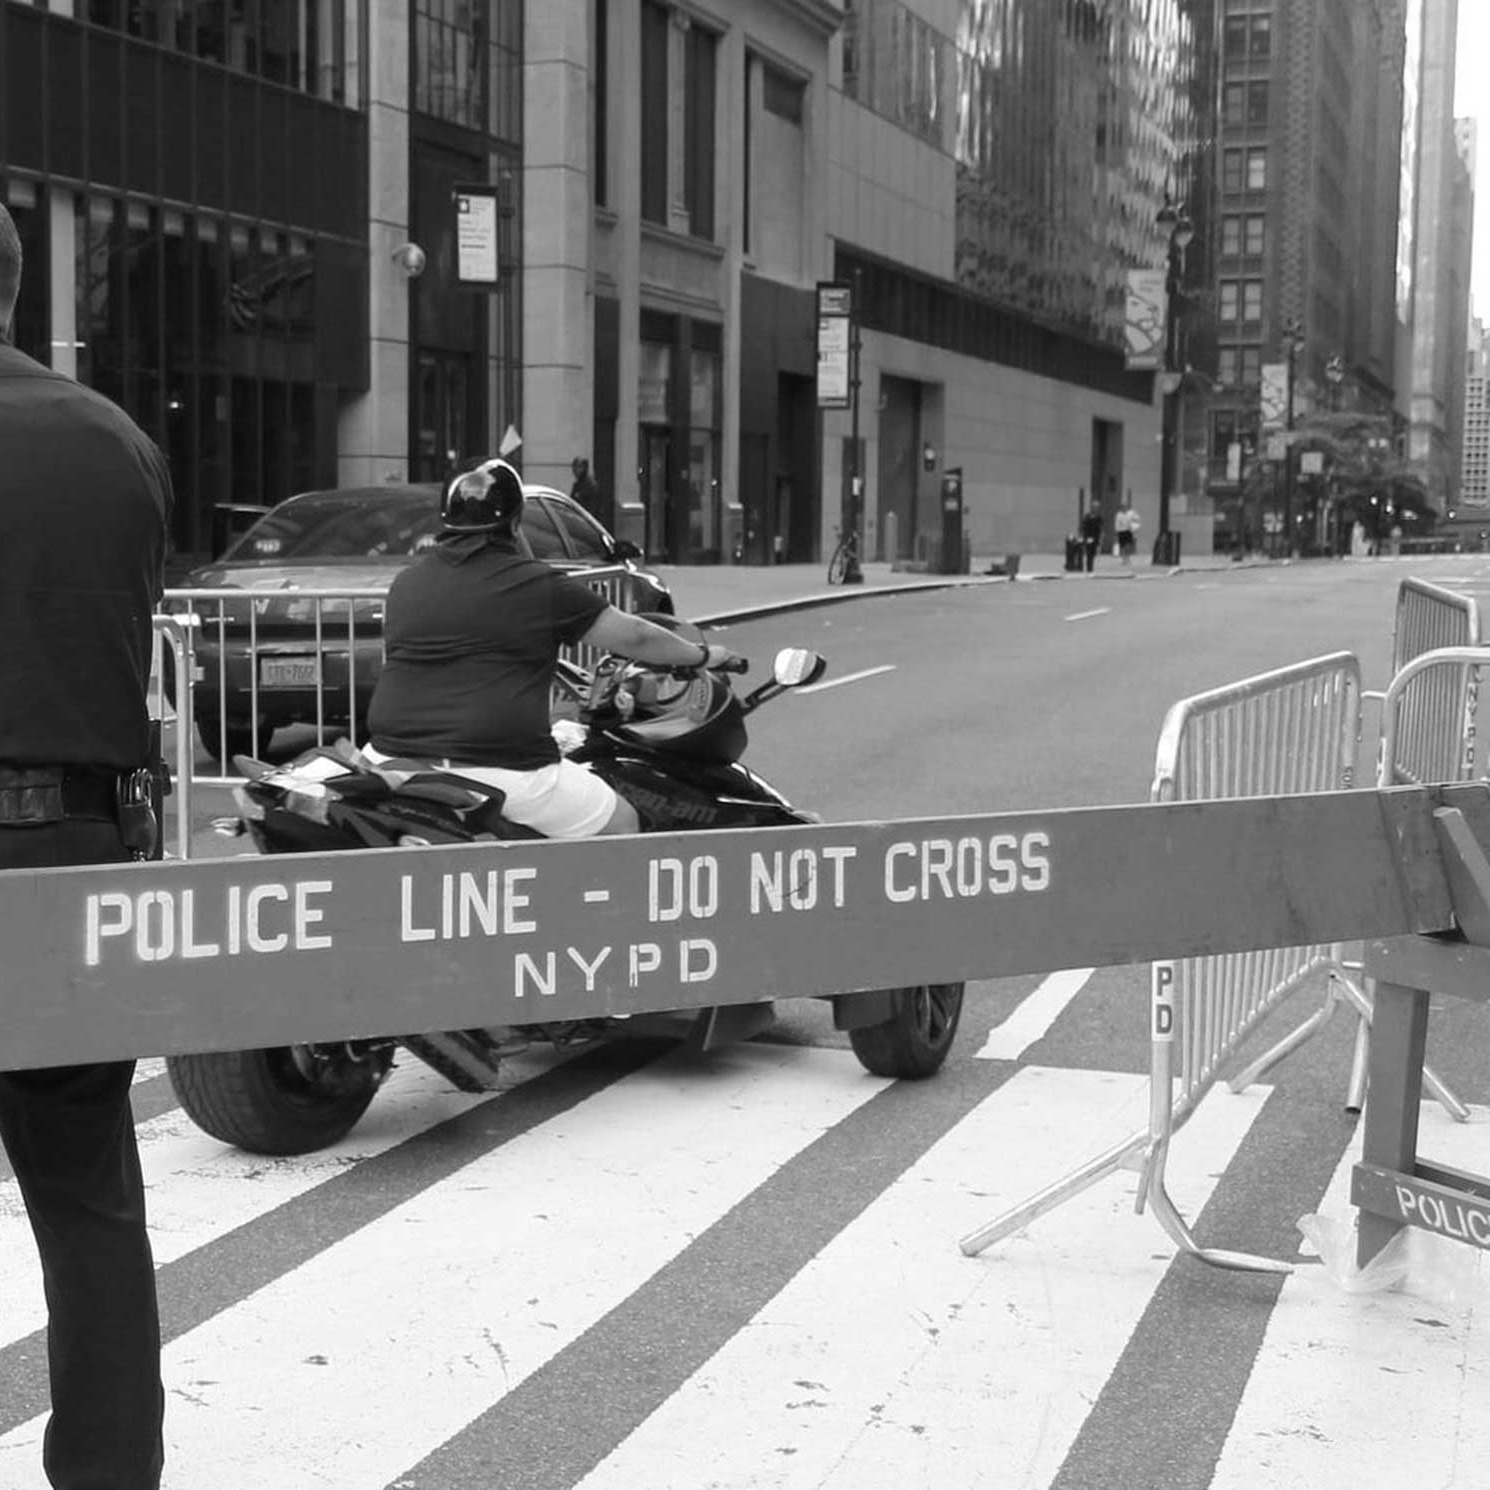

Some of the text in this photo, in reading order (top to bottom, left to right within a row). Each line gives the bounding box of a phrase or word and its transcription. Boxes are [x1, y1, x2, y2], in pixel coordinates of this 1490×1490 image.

[84, 880, 334, 966] POLICE
[401, 867, 538, 942] LINE
[648, 855, 719, 922] DO
[750, 848, 861, 914] NOT
[884, 832, 1051, 904] CROSS
[514, 938, 719, 998] NYPD
[1395, 1184, 1490, 1245] POLIC
